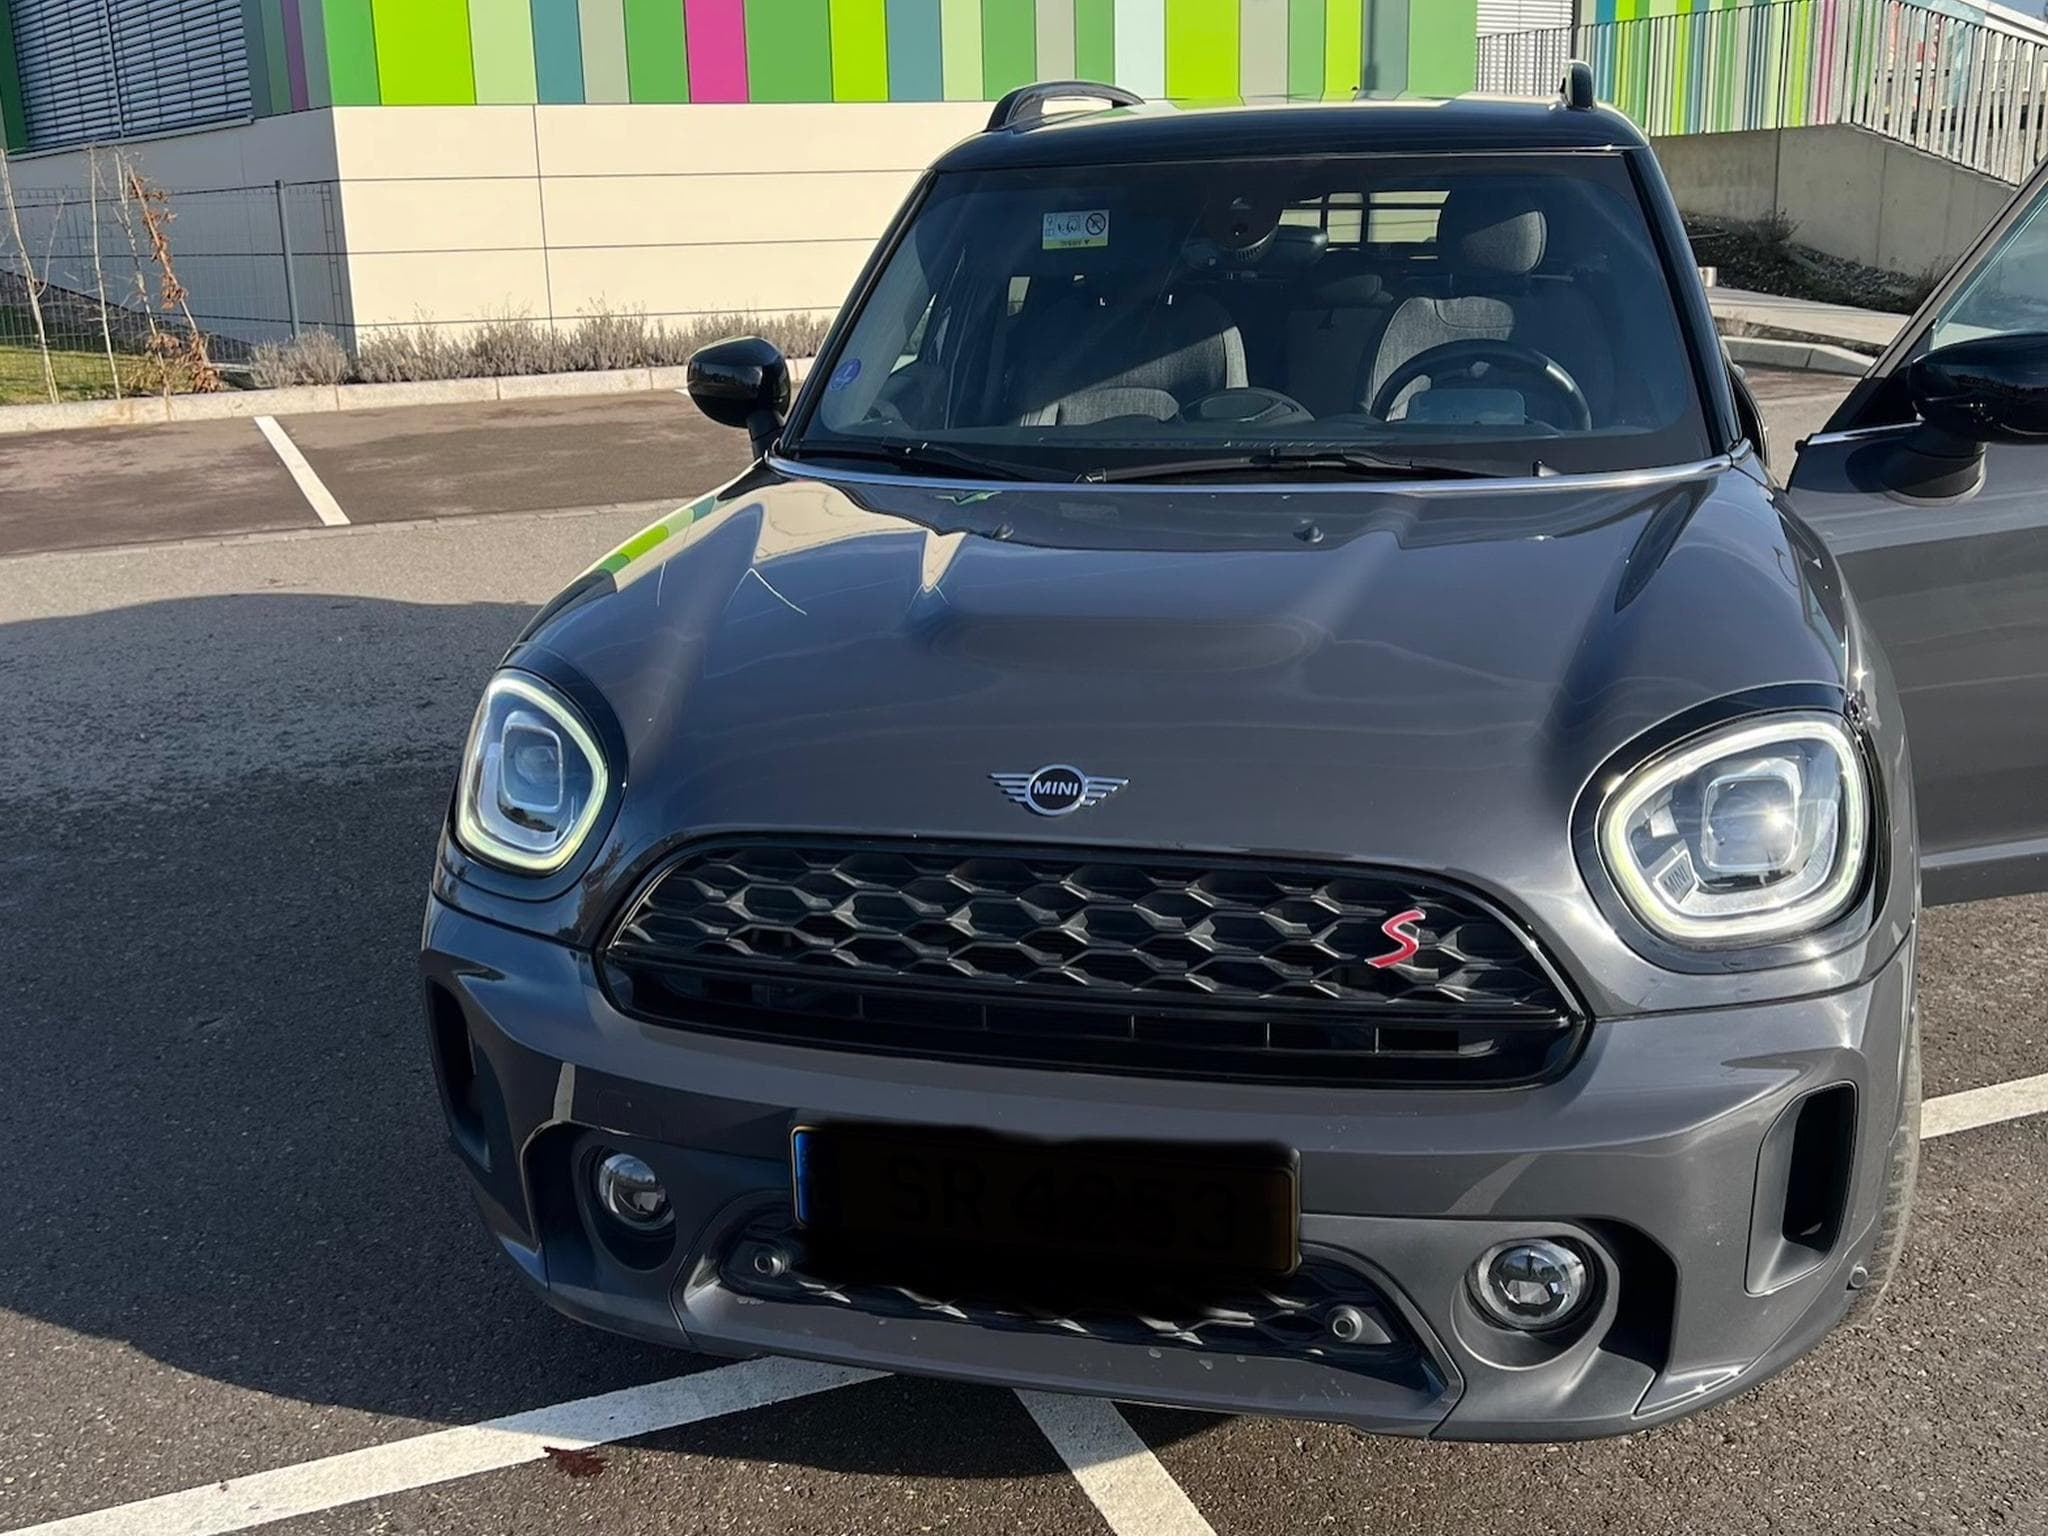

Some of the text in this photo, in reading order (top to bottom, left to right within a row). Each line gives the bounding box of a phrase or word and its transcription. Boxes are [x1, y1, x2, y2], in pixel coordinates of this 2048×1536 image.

[1033, 780, 1079, 796] MINI
[1663, 863, 1690, 893] MINI
[1364, 908, 1426, 968] S
